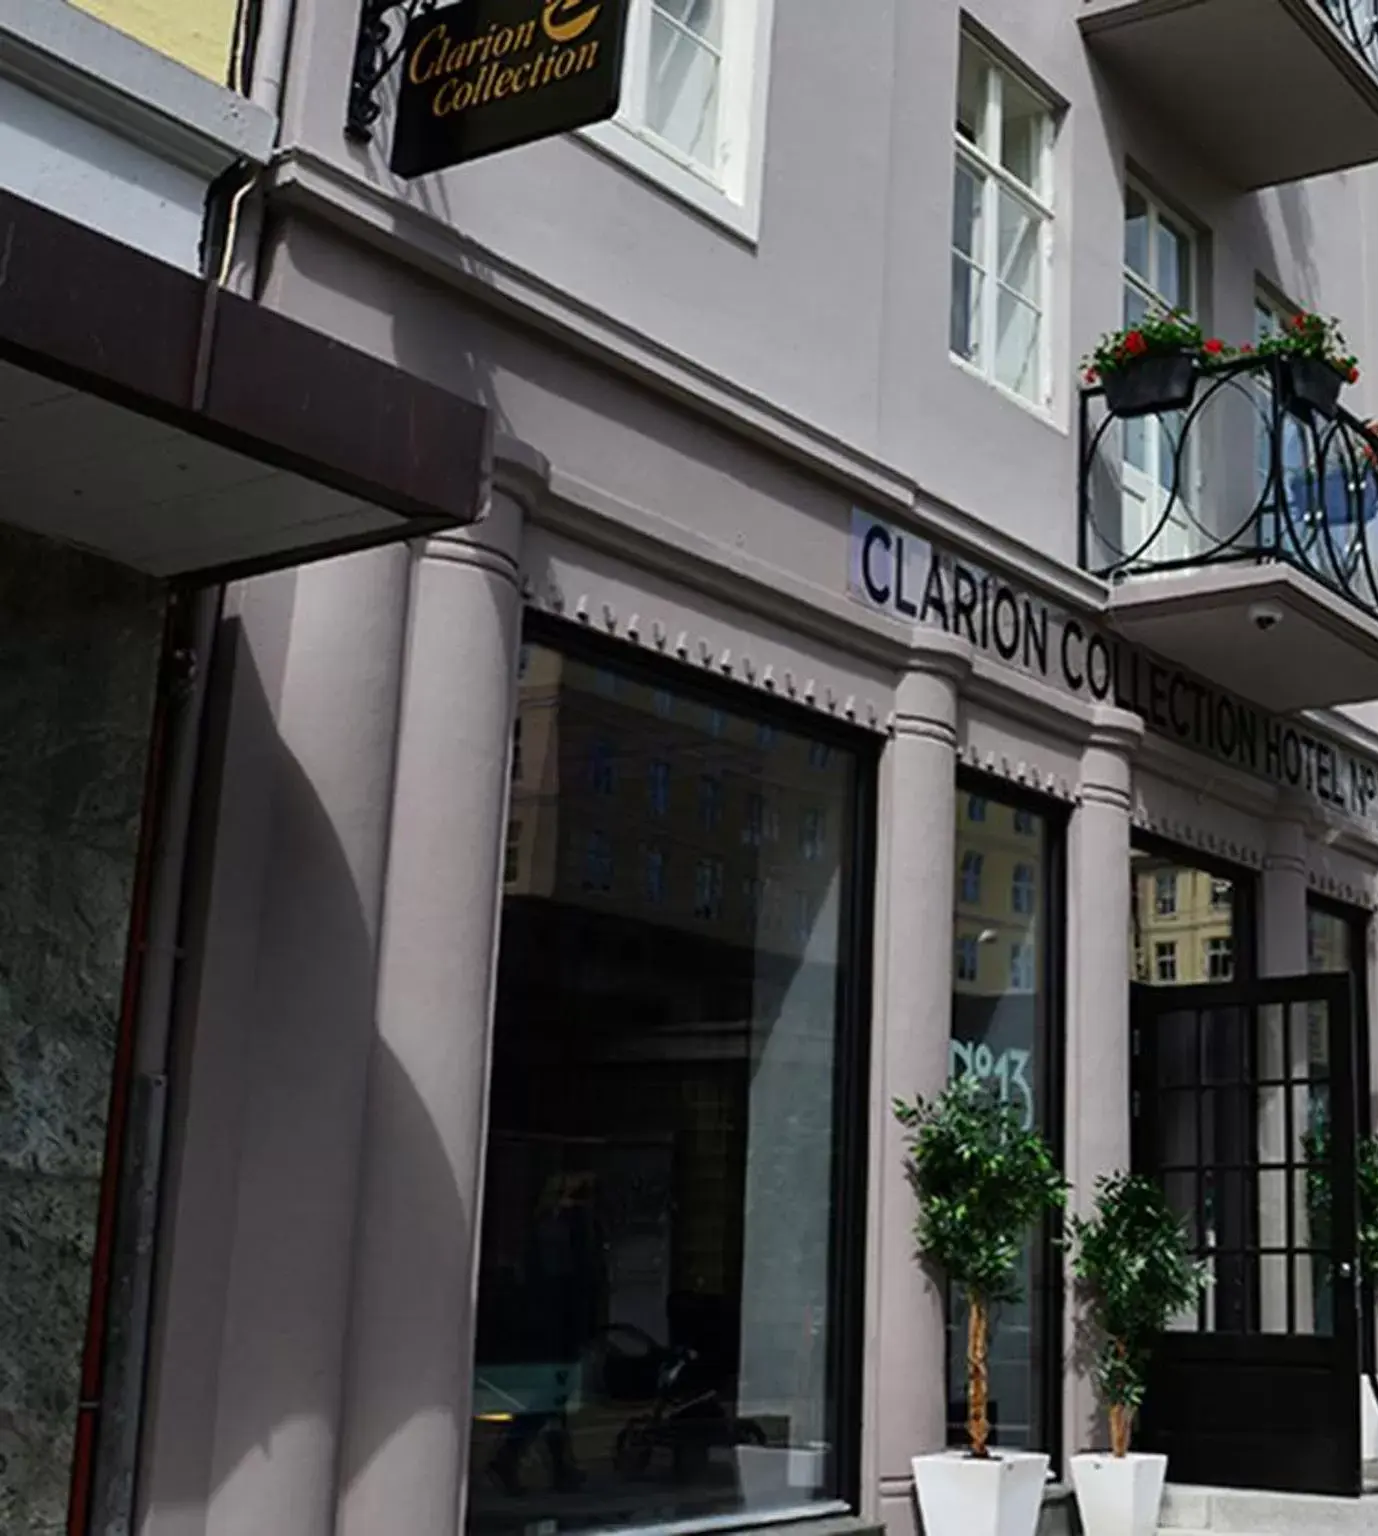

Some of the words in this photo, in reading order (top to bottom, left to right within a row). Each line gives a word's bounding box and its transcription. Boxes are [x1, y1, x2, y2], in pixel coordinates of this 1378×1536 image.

[410, 21, 535, 84] Clarion
[433, 42, 599, 117] Collection
[862, 525, 1048, 676] CLARION
[1061, 619, 1255, 768] COLLECTION
[1265, 717, 1344, 808] HOTEL
